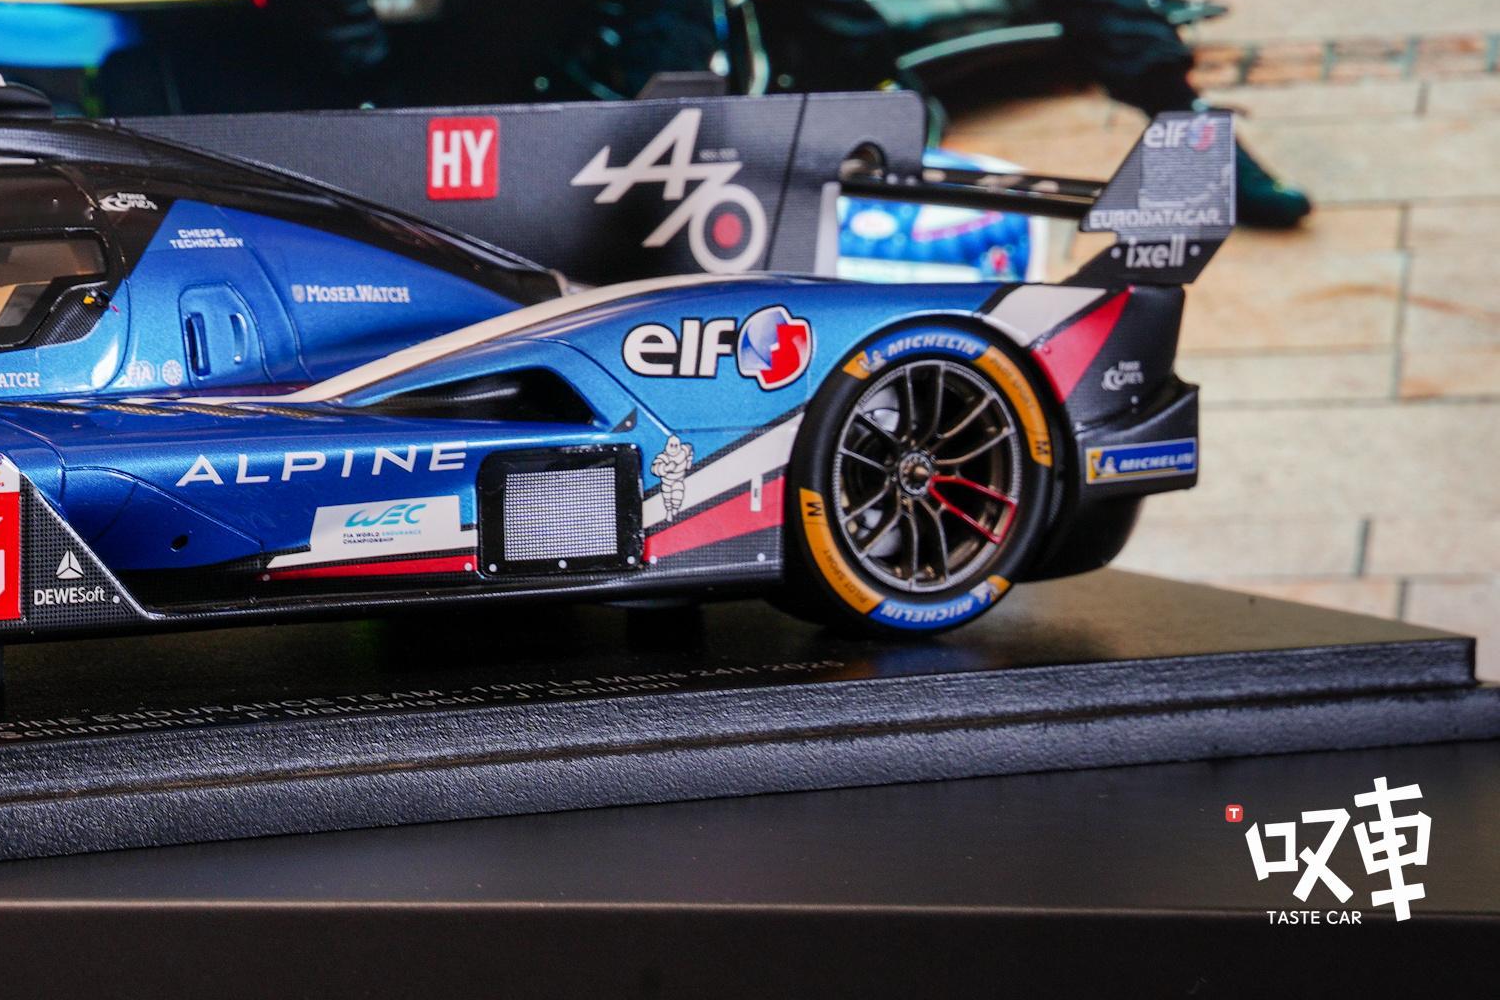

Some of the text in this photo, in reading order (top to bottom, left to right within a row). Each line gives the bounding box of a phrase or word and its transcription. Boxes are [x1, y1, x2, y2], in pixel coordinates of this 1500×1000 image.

[1143, 119, 1190, 149] elf
[431, 129, 493, 188] HY
[169, 237, 245, 249] TECHNOLOGY
[1125, 232, 1188, 269] ixell
[307, 284, 410, 304] MOSER.WATCH
[623, 317, 736, 378] elf
[887, 334, 977, 357] MICHELIN
[175, 440, 469, 488] ALPINE
[344, 503, 428, 528] WEC
[805, 500, 824, 518] M
[33, 586, 106, 606] DEWESoft
[879, 601, 973, 623] MICHELIN
